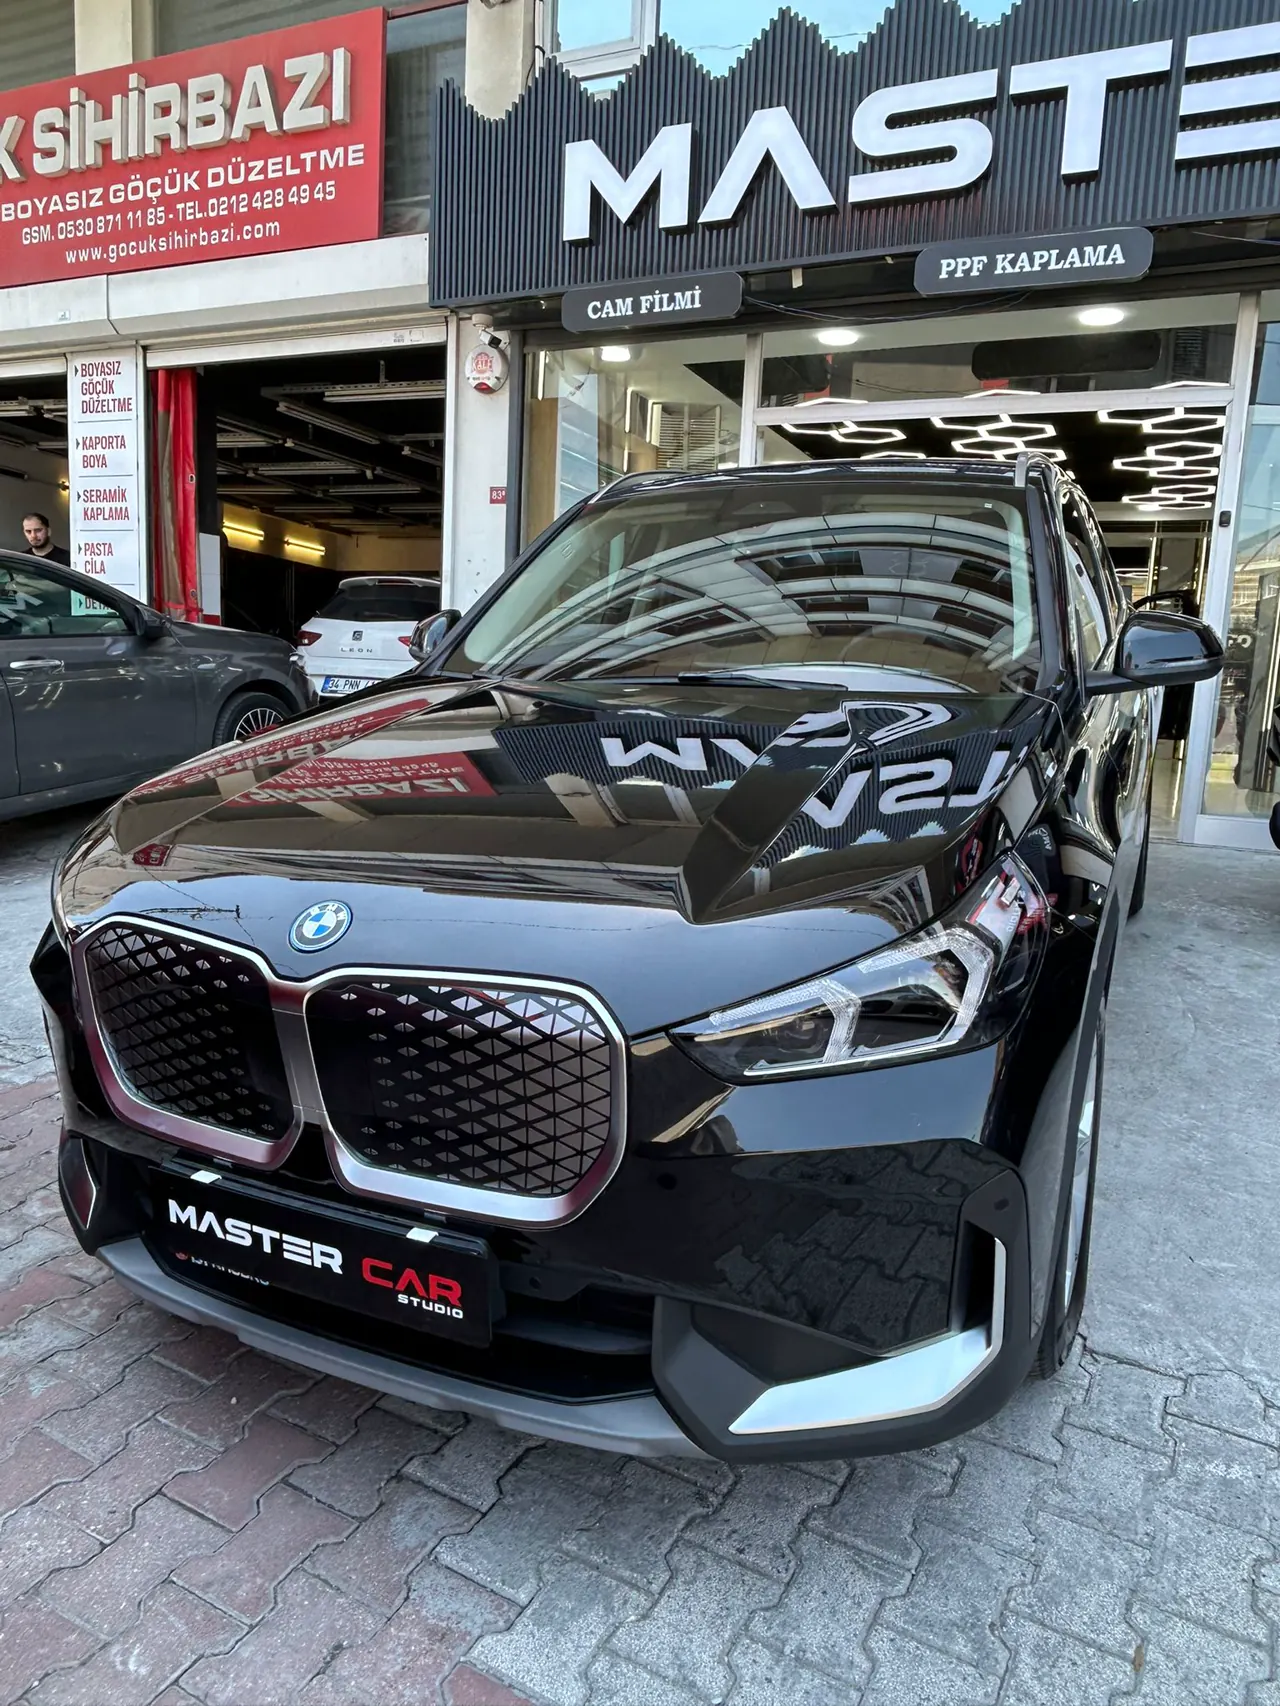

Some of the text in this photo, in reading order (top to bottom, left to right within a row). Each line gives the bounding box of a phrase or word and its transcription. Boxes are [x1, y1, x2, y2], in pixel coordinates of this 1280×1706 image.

[33, 47, 351, 178] SİHİRBAZI
[1, 144, 365, 222] BOYASIZ GÖÇÜK DÜZELTME
[22, 224, 55, 245] GSM.
[57, 217, 93, 240] 0530
[96, 213, 122, 234] 871
[127, 209, 142, 230] 11
[147, 206, 165, 226] 85
[252, 188, 284, 211] 428
[288, 183, 310, 206] 49
[313, 180, 336, 202] 45
[66, 220, 281, 264] www.gocuksihirbazi.com
[938, 243, 1127, 280] PPF KAPLAMA
[587, 285, 702, 320] CAM FİLMİ
[80, 360, 122, 378] BOYASIZ
[81, 378, 115, 399] GÖÇÜK
[81, 397, 133, 414] DÜZELTME
[82, 435, 127, 451] KAPORTA
[82, 454, 108, 469] BOYA
[82, 486, 128, 504] SERAMİK
[83, 507, 130, 521] KAPLAMA
[84, 543, 114, 557] PASTA
[84, 558, 106, 575] CİLA
[329, 679, 340, 689] 34
[343, 680, 361, 690] PNN
[168, 1198, 343, 1275] MASTER
[361, 1257, 463, 1307] CAR
[397, 1293, 464, 1319] STUDIO
